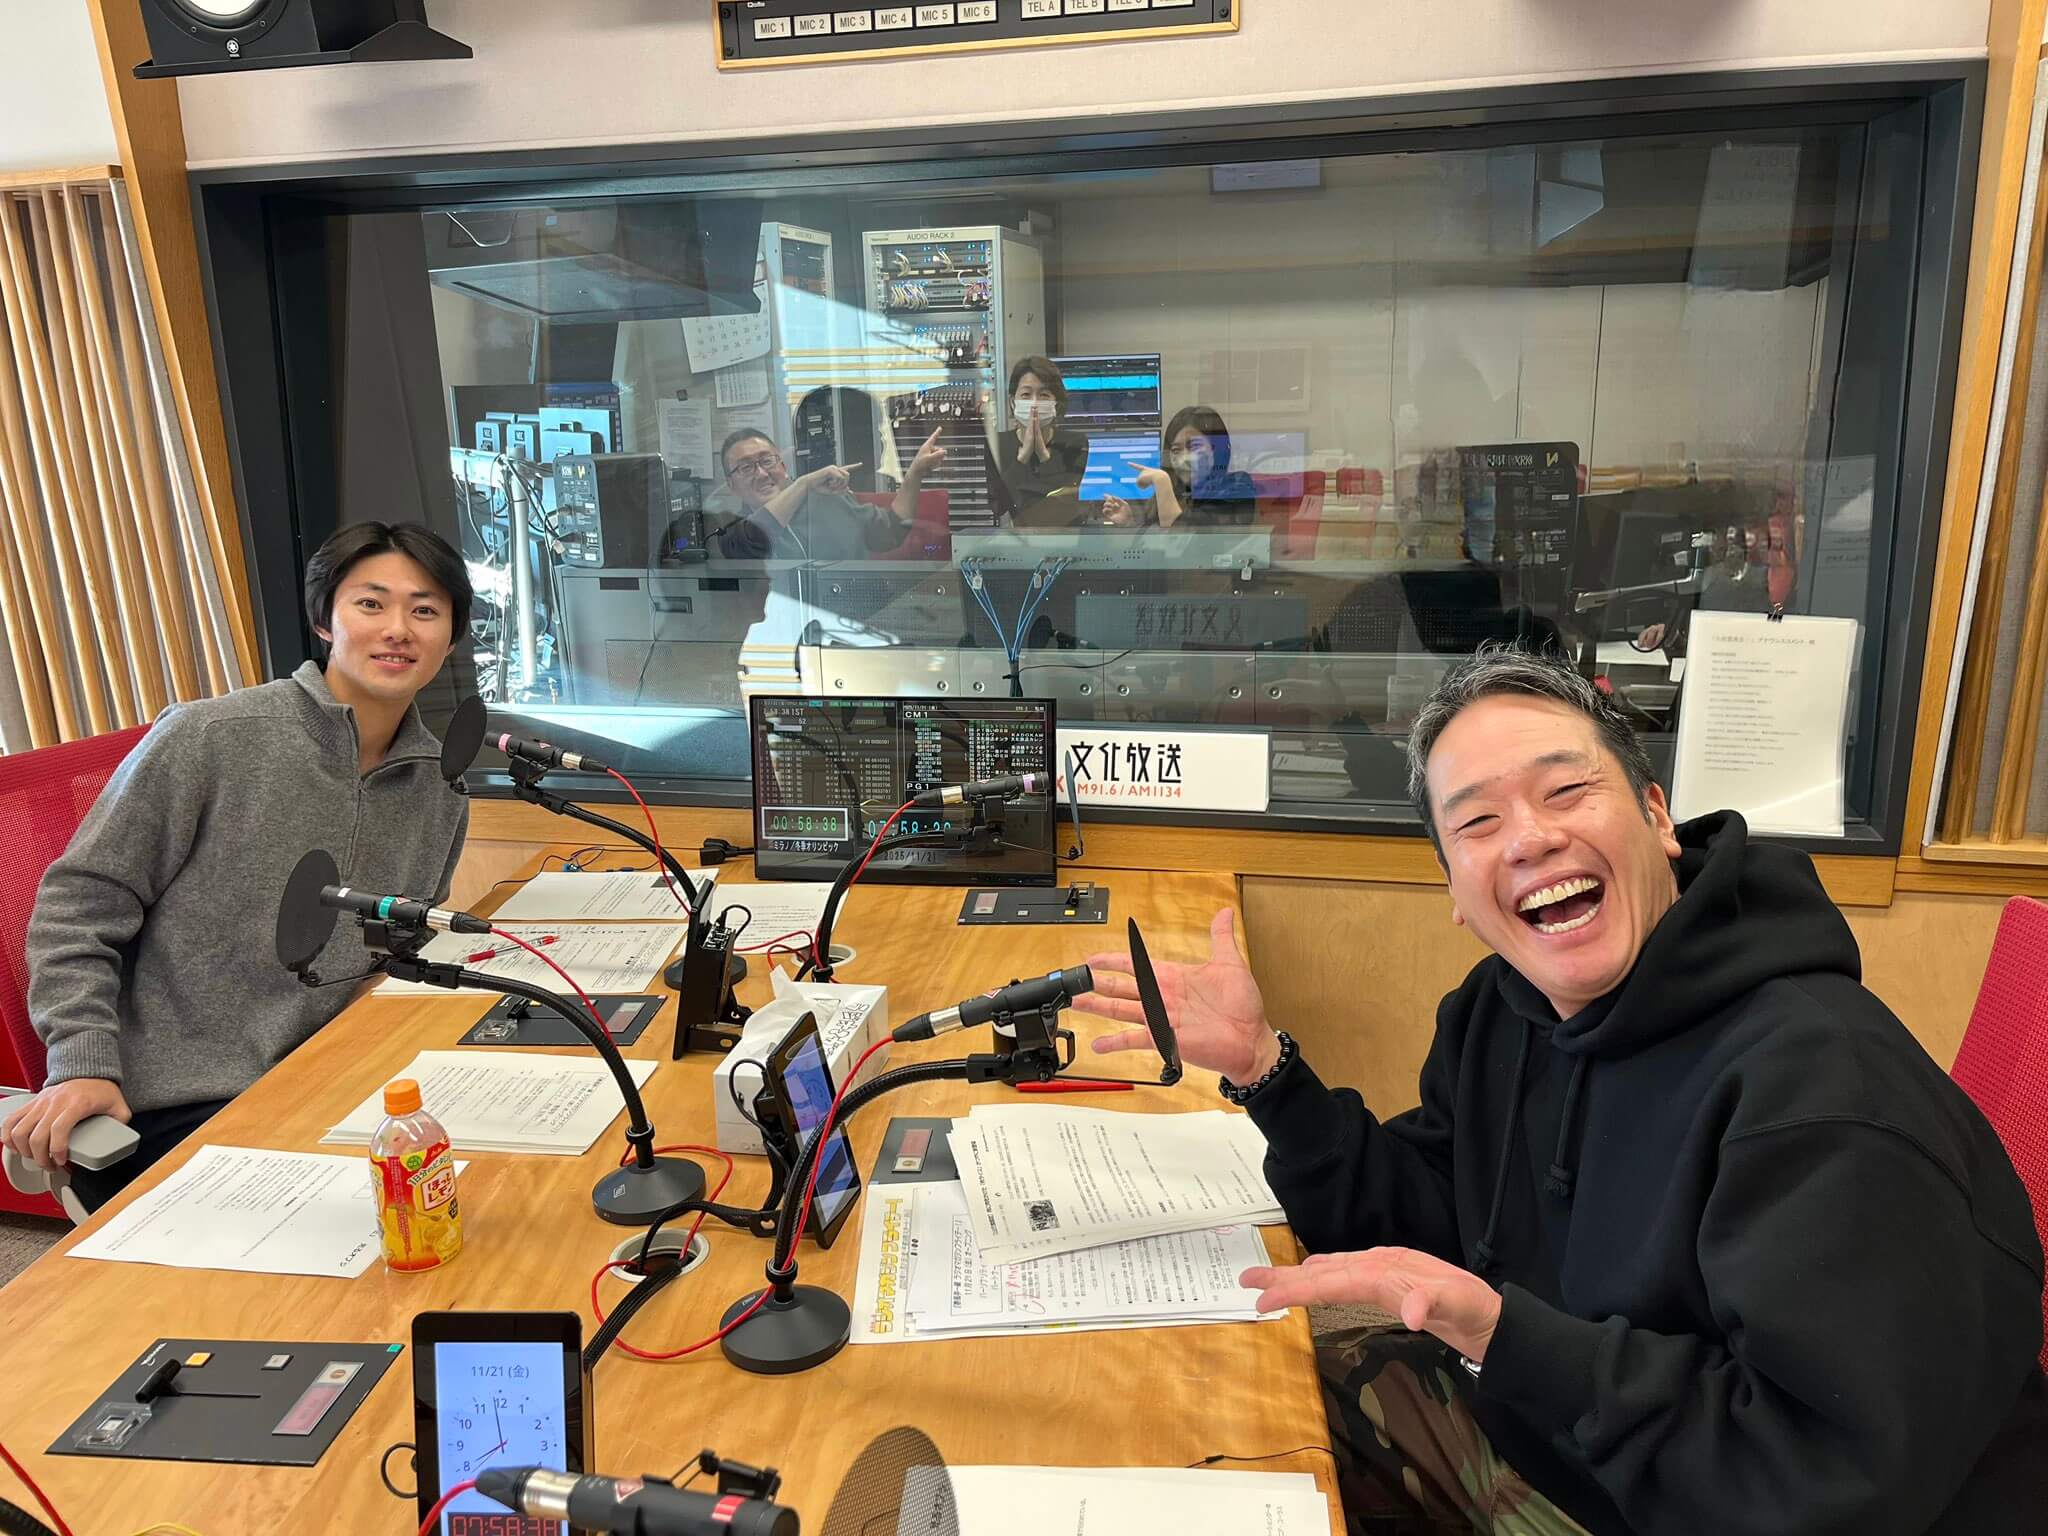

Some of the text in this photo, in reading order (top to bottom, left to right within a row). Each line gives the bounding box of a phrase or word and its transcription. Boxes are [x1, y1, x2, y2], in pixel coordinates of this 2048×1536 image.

[1028, 1, 1055, 13] TEL A
[1072, 0, 1098, 9] TEL B
[921, 9, 948, 21] MIC 5
[963, 6, 990, 18] MIC 6
[840, 17, 865, 28] MIC 3
[880, 13, 907, 25] MIC 4
[760, 22, 785, 33] MIC 1
[799, 20, 825, 31] MIC 2
[906, 232, 929, 241] AUDIO
[1070, 741, 1182, 783] 文化放送
[1077, 783, 1182, 798] M91.6/AM1134
[773, 815, 838, 832] 00:58:38
[471, 1364, 530, 1379] 11/21 (金)
[475, 1403, 486, 1414] 11
[496, 1398, 508, 1409] 12
[519, 1404, 525, 1414] 1
[459, 1419, 472, 1430] 10
[535, 1419, 542, 1430] 2
[456, 1440, 464, 1450] 9
[541, 1440, 548, 1451] 3
[463, 1461, 471, 1471] 8
